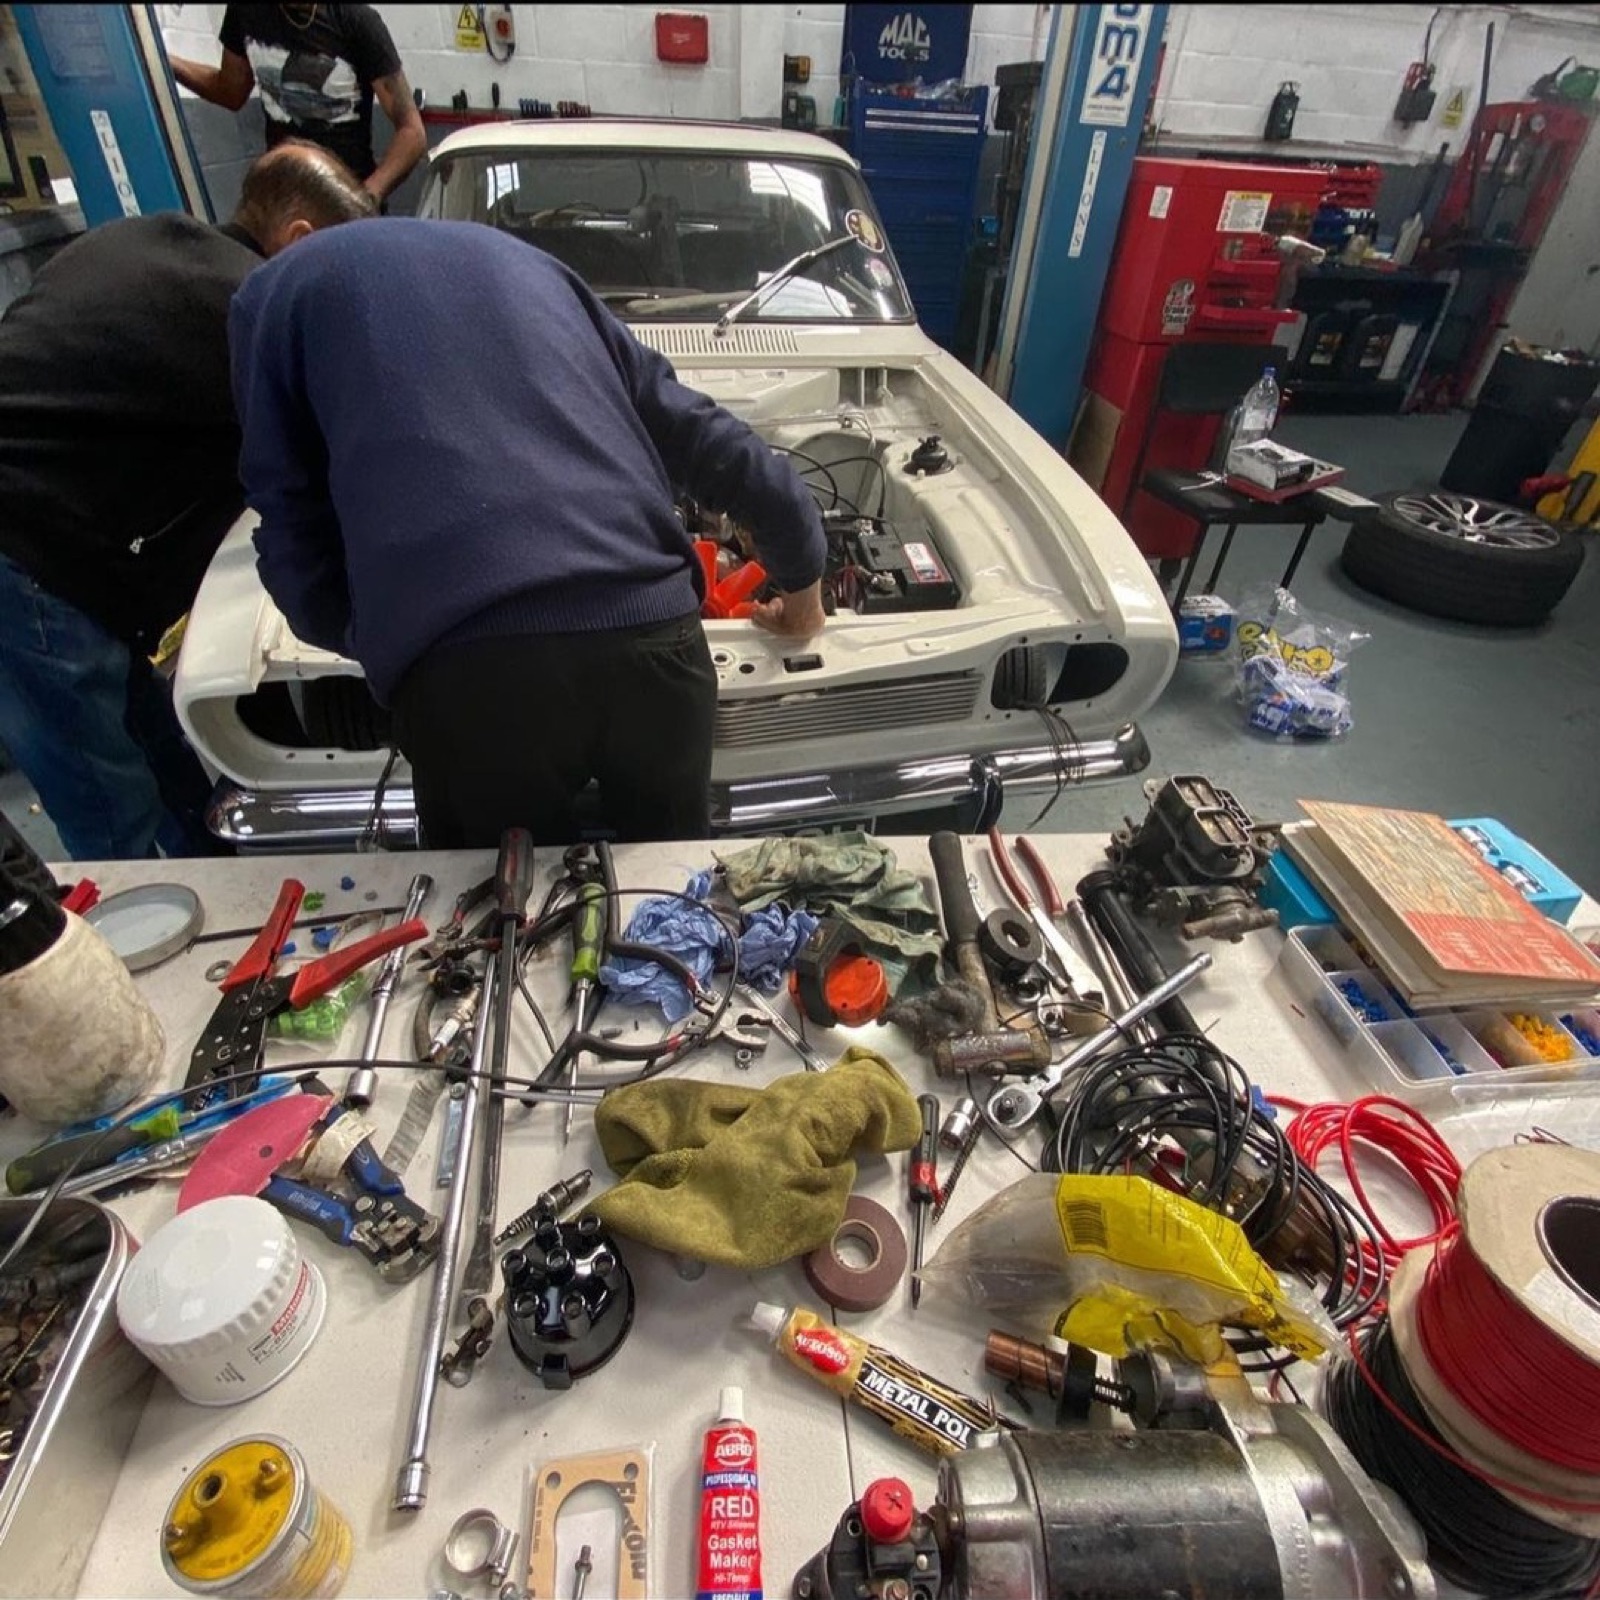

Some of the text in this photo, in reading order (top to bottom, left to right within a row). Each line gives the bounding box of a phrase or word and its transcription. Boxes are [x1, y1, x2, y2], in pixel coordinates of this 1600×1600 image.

[879, 13, 930, 47] MAC
[878, 46, 930, 60] TOS
[864, 1370, 929, 1419] METAL
[714, 1442, 753, 1458] ABRO
[711, 1495, 754, 1519] RED
[708, 1533, 758, 1550] Gasket
[710, 1552, 753, 1569] Maker
